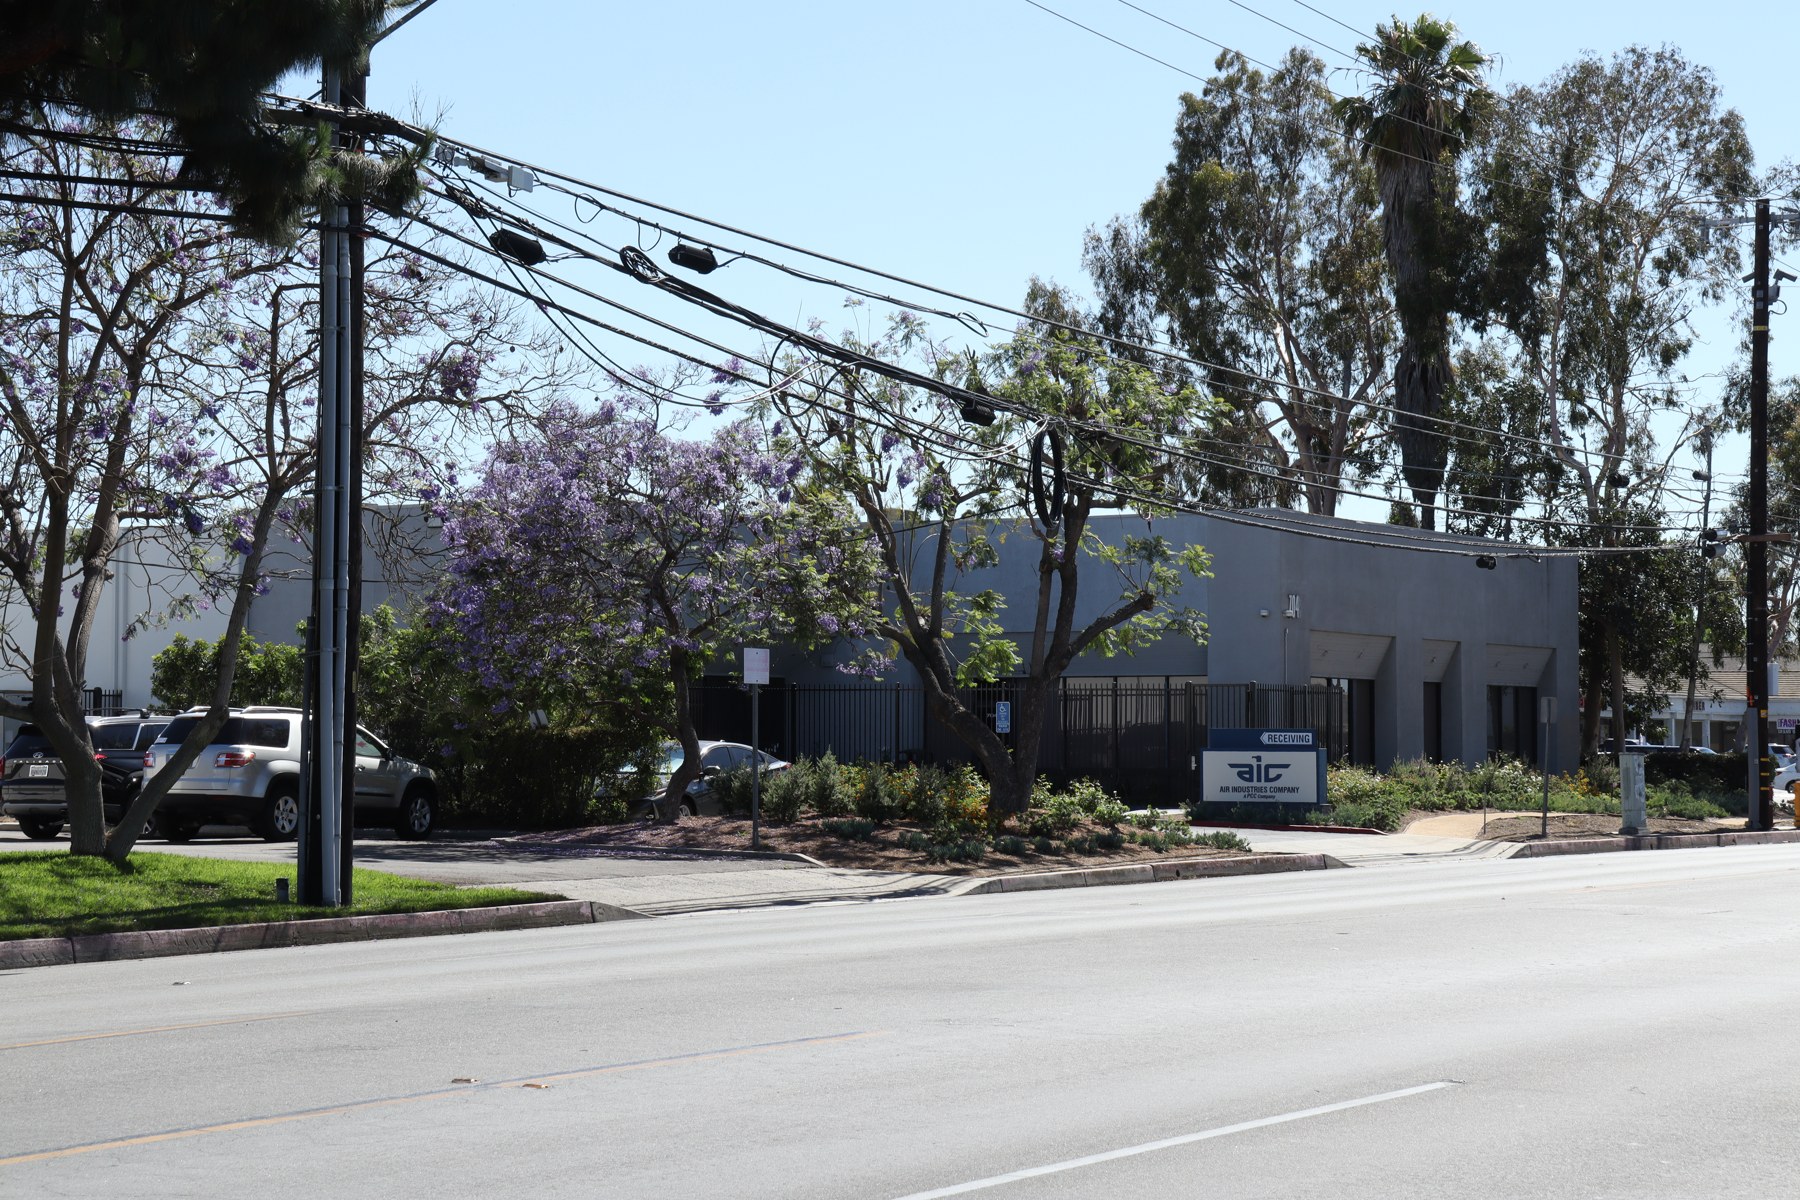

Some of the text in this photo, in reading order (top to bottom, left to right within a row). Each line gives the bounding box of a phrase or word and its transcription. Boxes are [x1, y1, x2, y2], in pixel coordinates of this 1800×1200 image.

[1267, 734, 1310, 743] RECEIVING
[1231, 786, 1268, 794] INDUSTRIES
[1269, 786, 1300, 794] COMPANY
